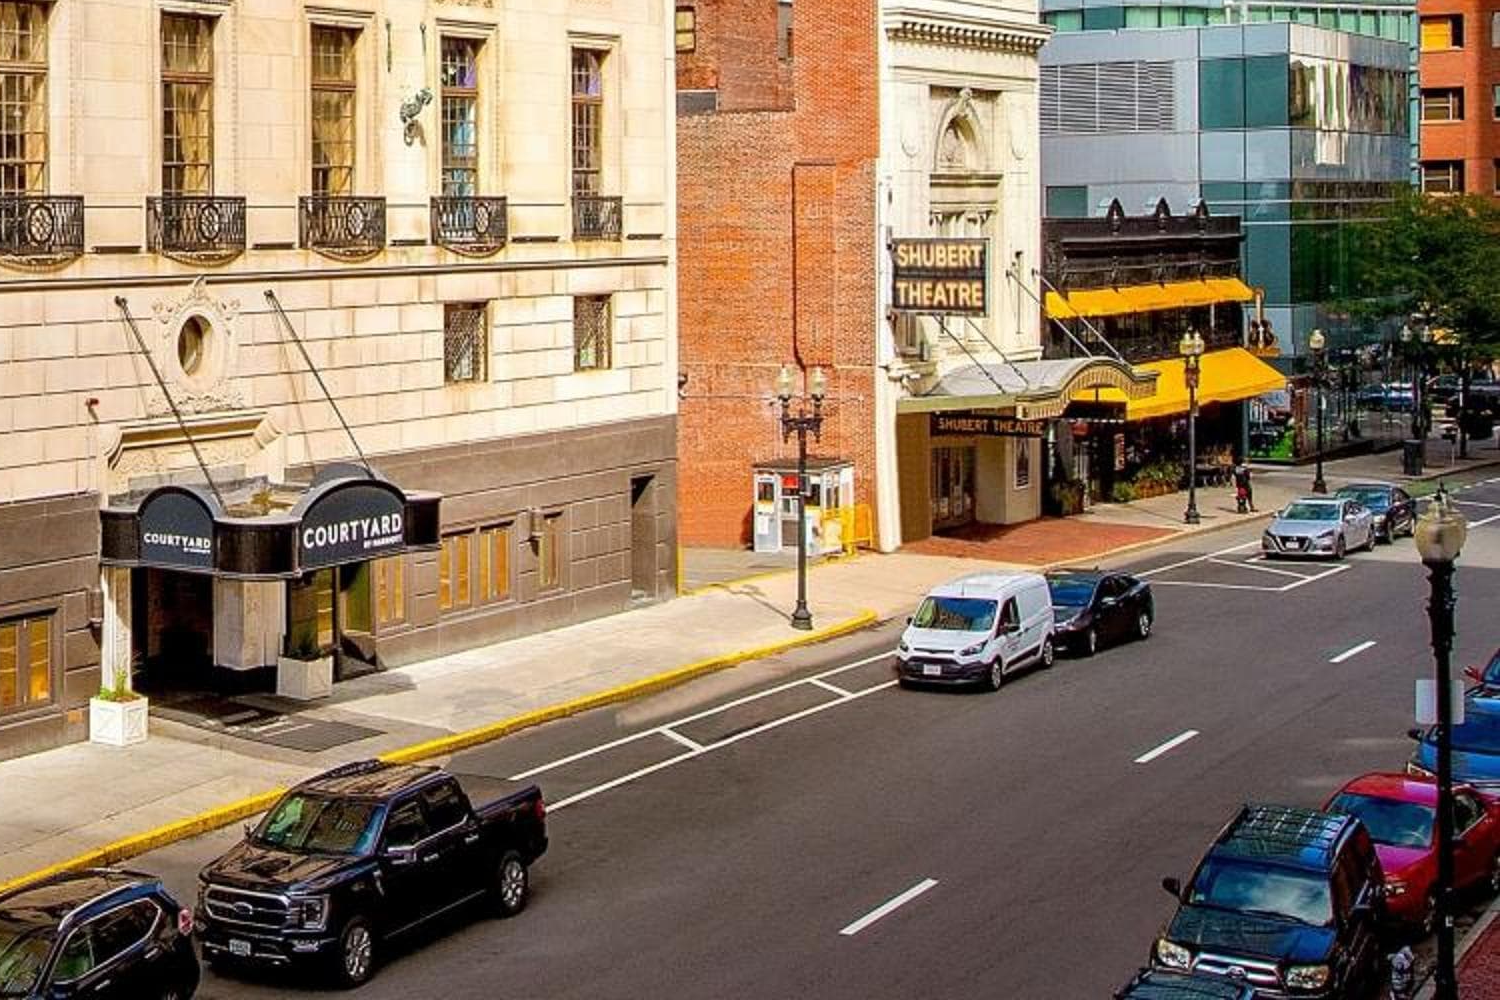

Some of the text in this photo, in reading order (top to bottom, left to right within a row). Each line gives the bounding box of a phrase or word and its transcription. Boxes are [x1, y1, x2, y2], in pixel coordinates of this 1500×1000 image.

[897, 243, 982, 267] SHUBERT
[895, 281, 983, 307] THEATRE
[937, 418, 1044, 434] SHUBERT THEATRE
[143, 532, 211, 549] COURTYARD
[303, 513, 402, 549] COURTYARD
